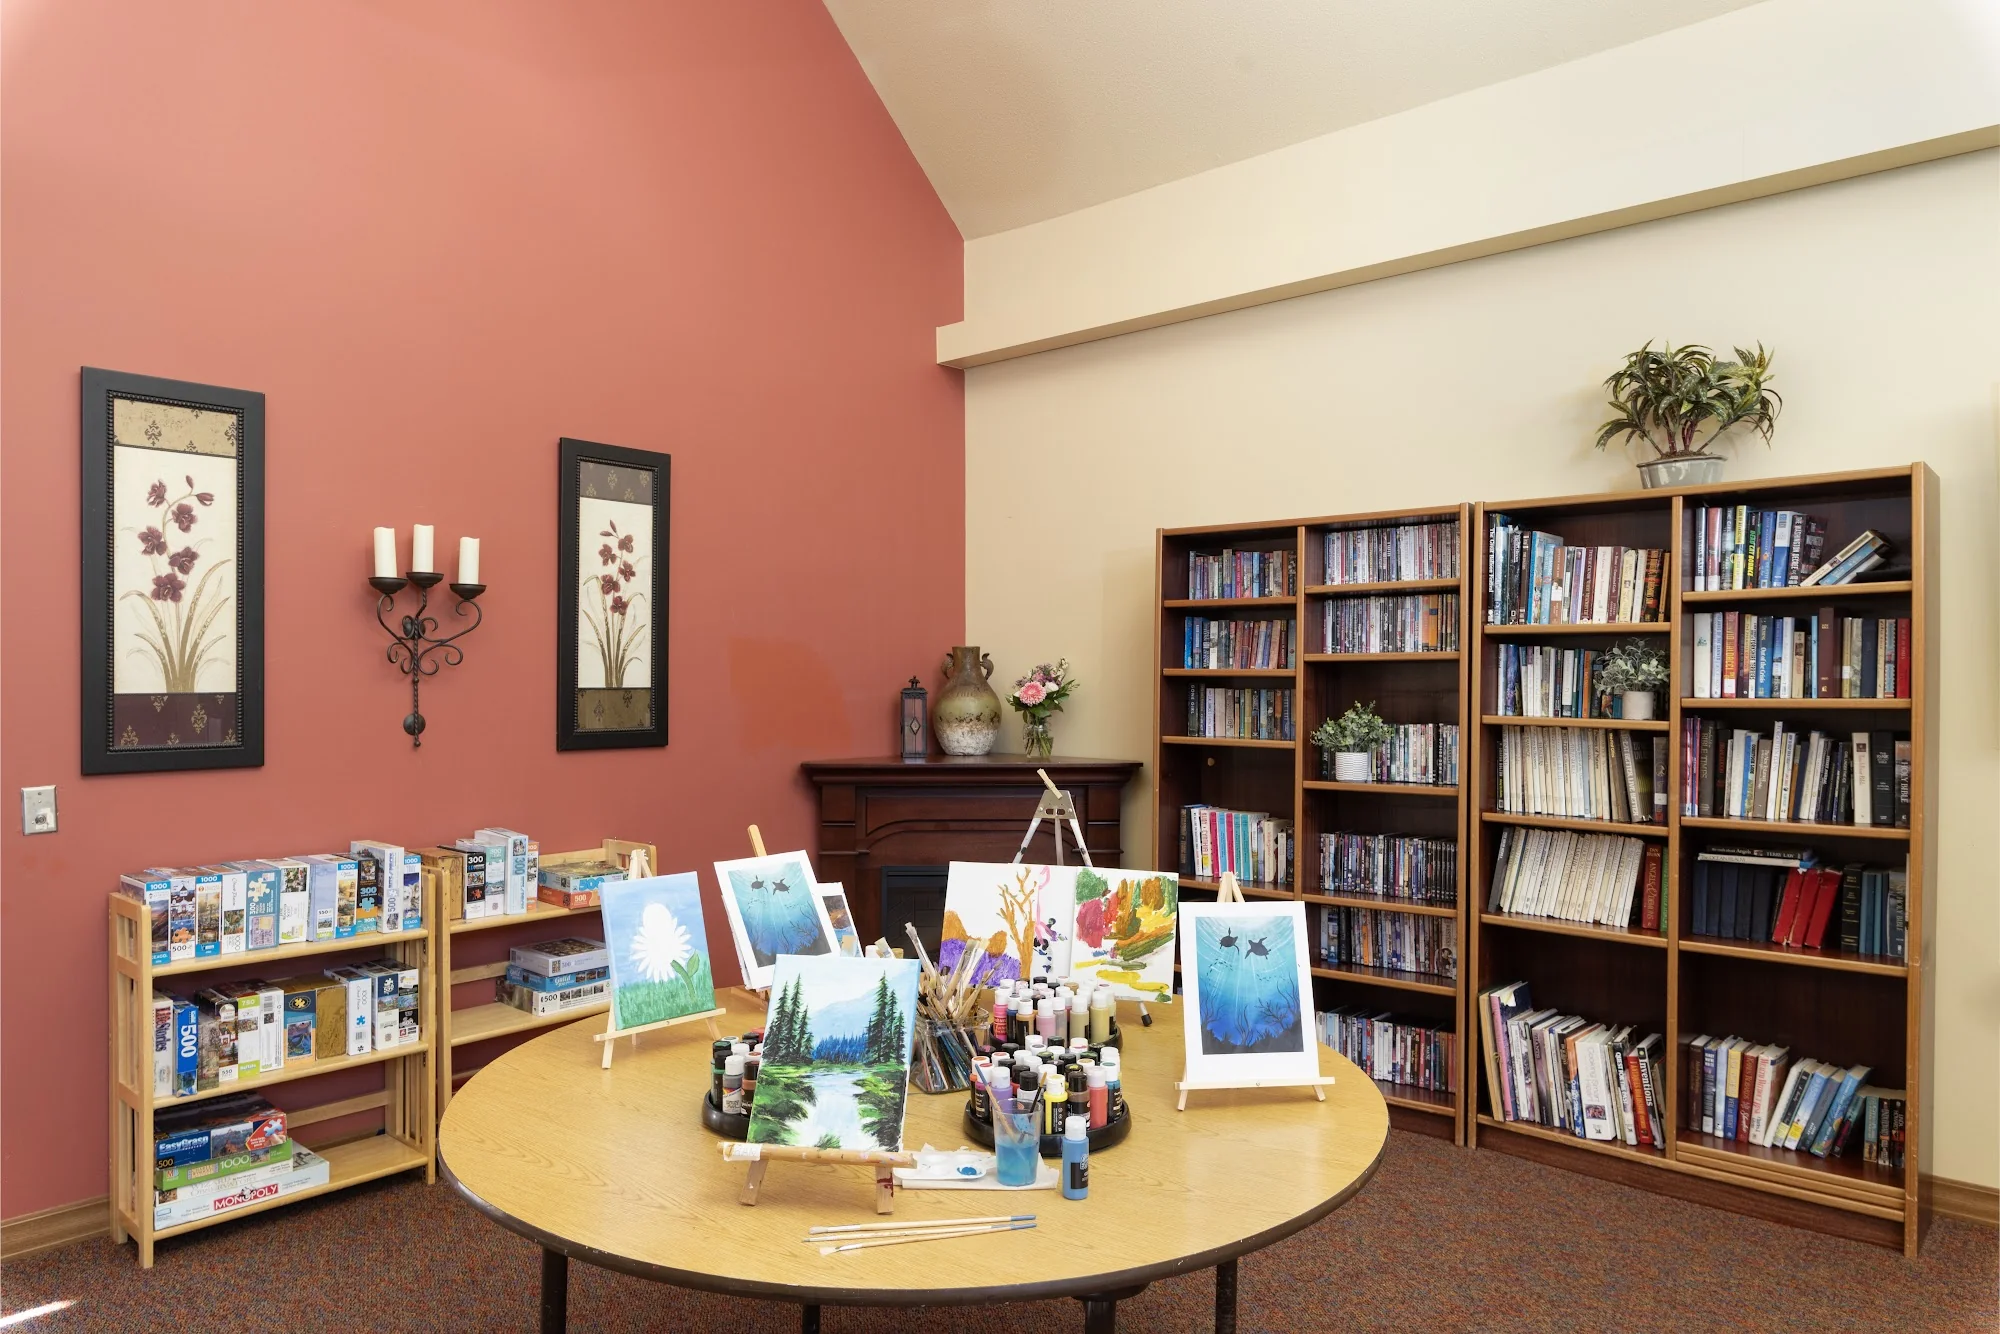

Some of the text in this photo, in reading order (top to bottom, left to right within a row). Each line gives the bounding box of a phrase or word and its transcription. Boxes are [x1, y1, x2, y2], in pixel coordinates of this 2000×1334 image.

[1792, 525, 1802, 552] WASHINGTON
[1790, 553, 1799, 570] DECREE
[1624, 753, 1633, 777] BETTER
[1628, 778, 1636, 792] LIVE
[1900, 762, 1908, 803] HOLY BIBLE
[1630, 793, 1639, 816] BETTER
[468, 856, 484, 864] 300
[514, 857, 526, 875] 300
[1647, 862, 1657, 886] ANGELS
[360, 886, 377, 894] 300
[574, 894, 587, 902] 500
[172, 944, 187, 952] 500
[544, 994, 558, 1003] 500
[540, 1006, 545, 1014] 4
[181, 1024, 197, 1058] 500
[1615, 1052, 1623, 1070] QUEST
[1640, 1059, 1653, 1107] Inventions
[158, 1159, 174, 1168] 500
[220, 1155, 250, 1169] 1000
[215, 1185, 277, 1209] MONOPOLY
